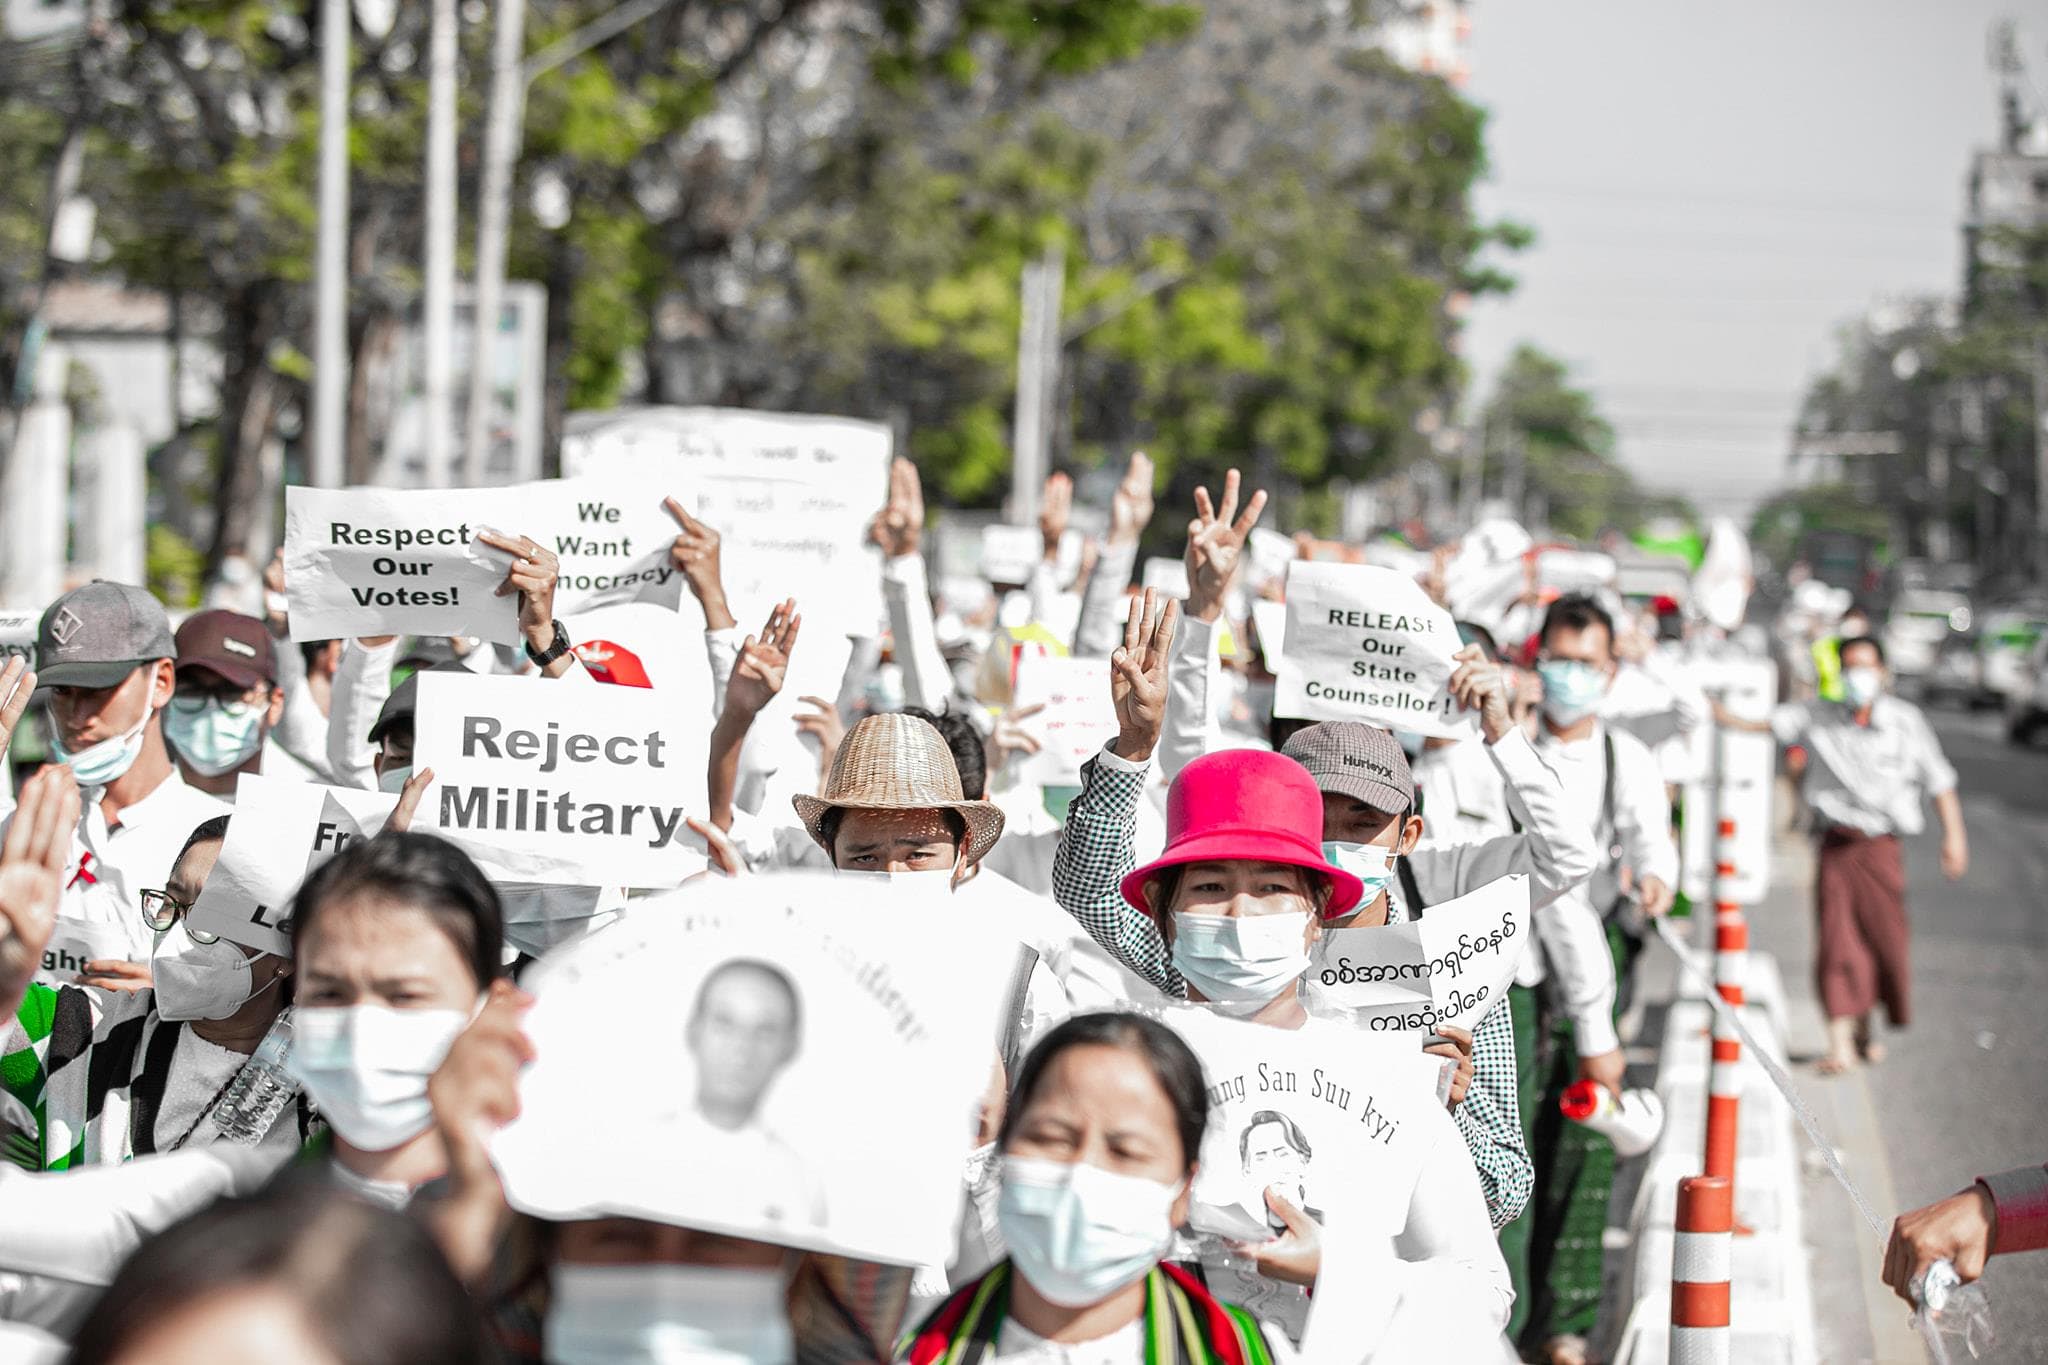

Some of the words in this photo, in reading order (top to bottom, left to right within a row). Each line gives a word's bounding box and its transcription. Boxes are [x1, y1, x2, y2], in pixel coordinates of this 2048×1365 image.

[578, 502, 621, 523] We
[330, 522, 470, 550] Respect
[556, 535, 633, 557] Want
[373, 557, 434, 576] Our
[351, 587, 460, 607] Votes!
[1362, 637, 1406, 657] Our
[1352, 660, 1417, 683] State
[1305, 681, 1437, 712] Counsellor
[462, 716, 666, 773] Reject
[439, 785, 684, 848] Military
[42, 949, 89, 976] ght
[1206, 1075, 1246, 1105] ung
[1257, 1062, 1297, 1093] San
[1311, 1068, 1351, 1111] Suu
[1360, 1095, 1400, 1145] kyi
